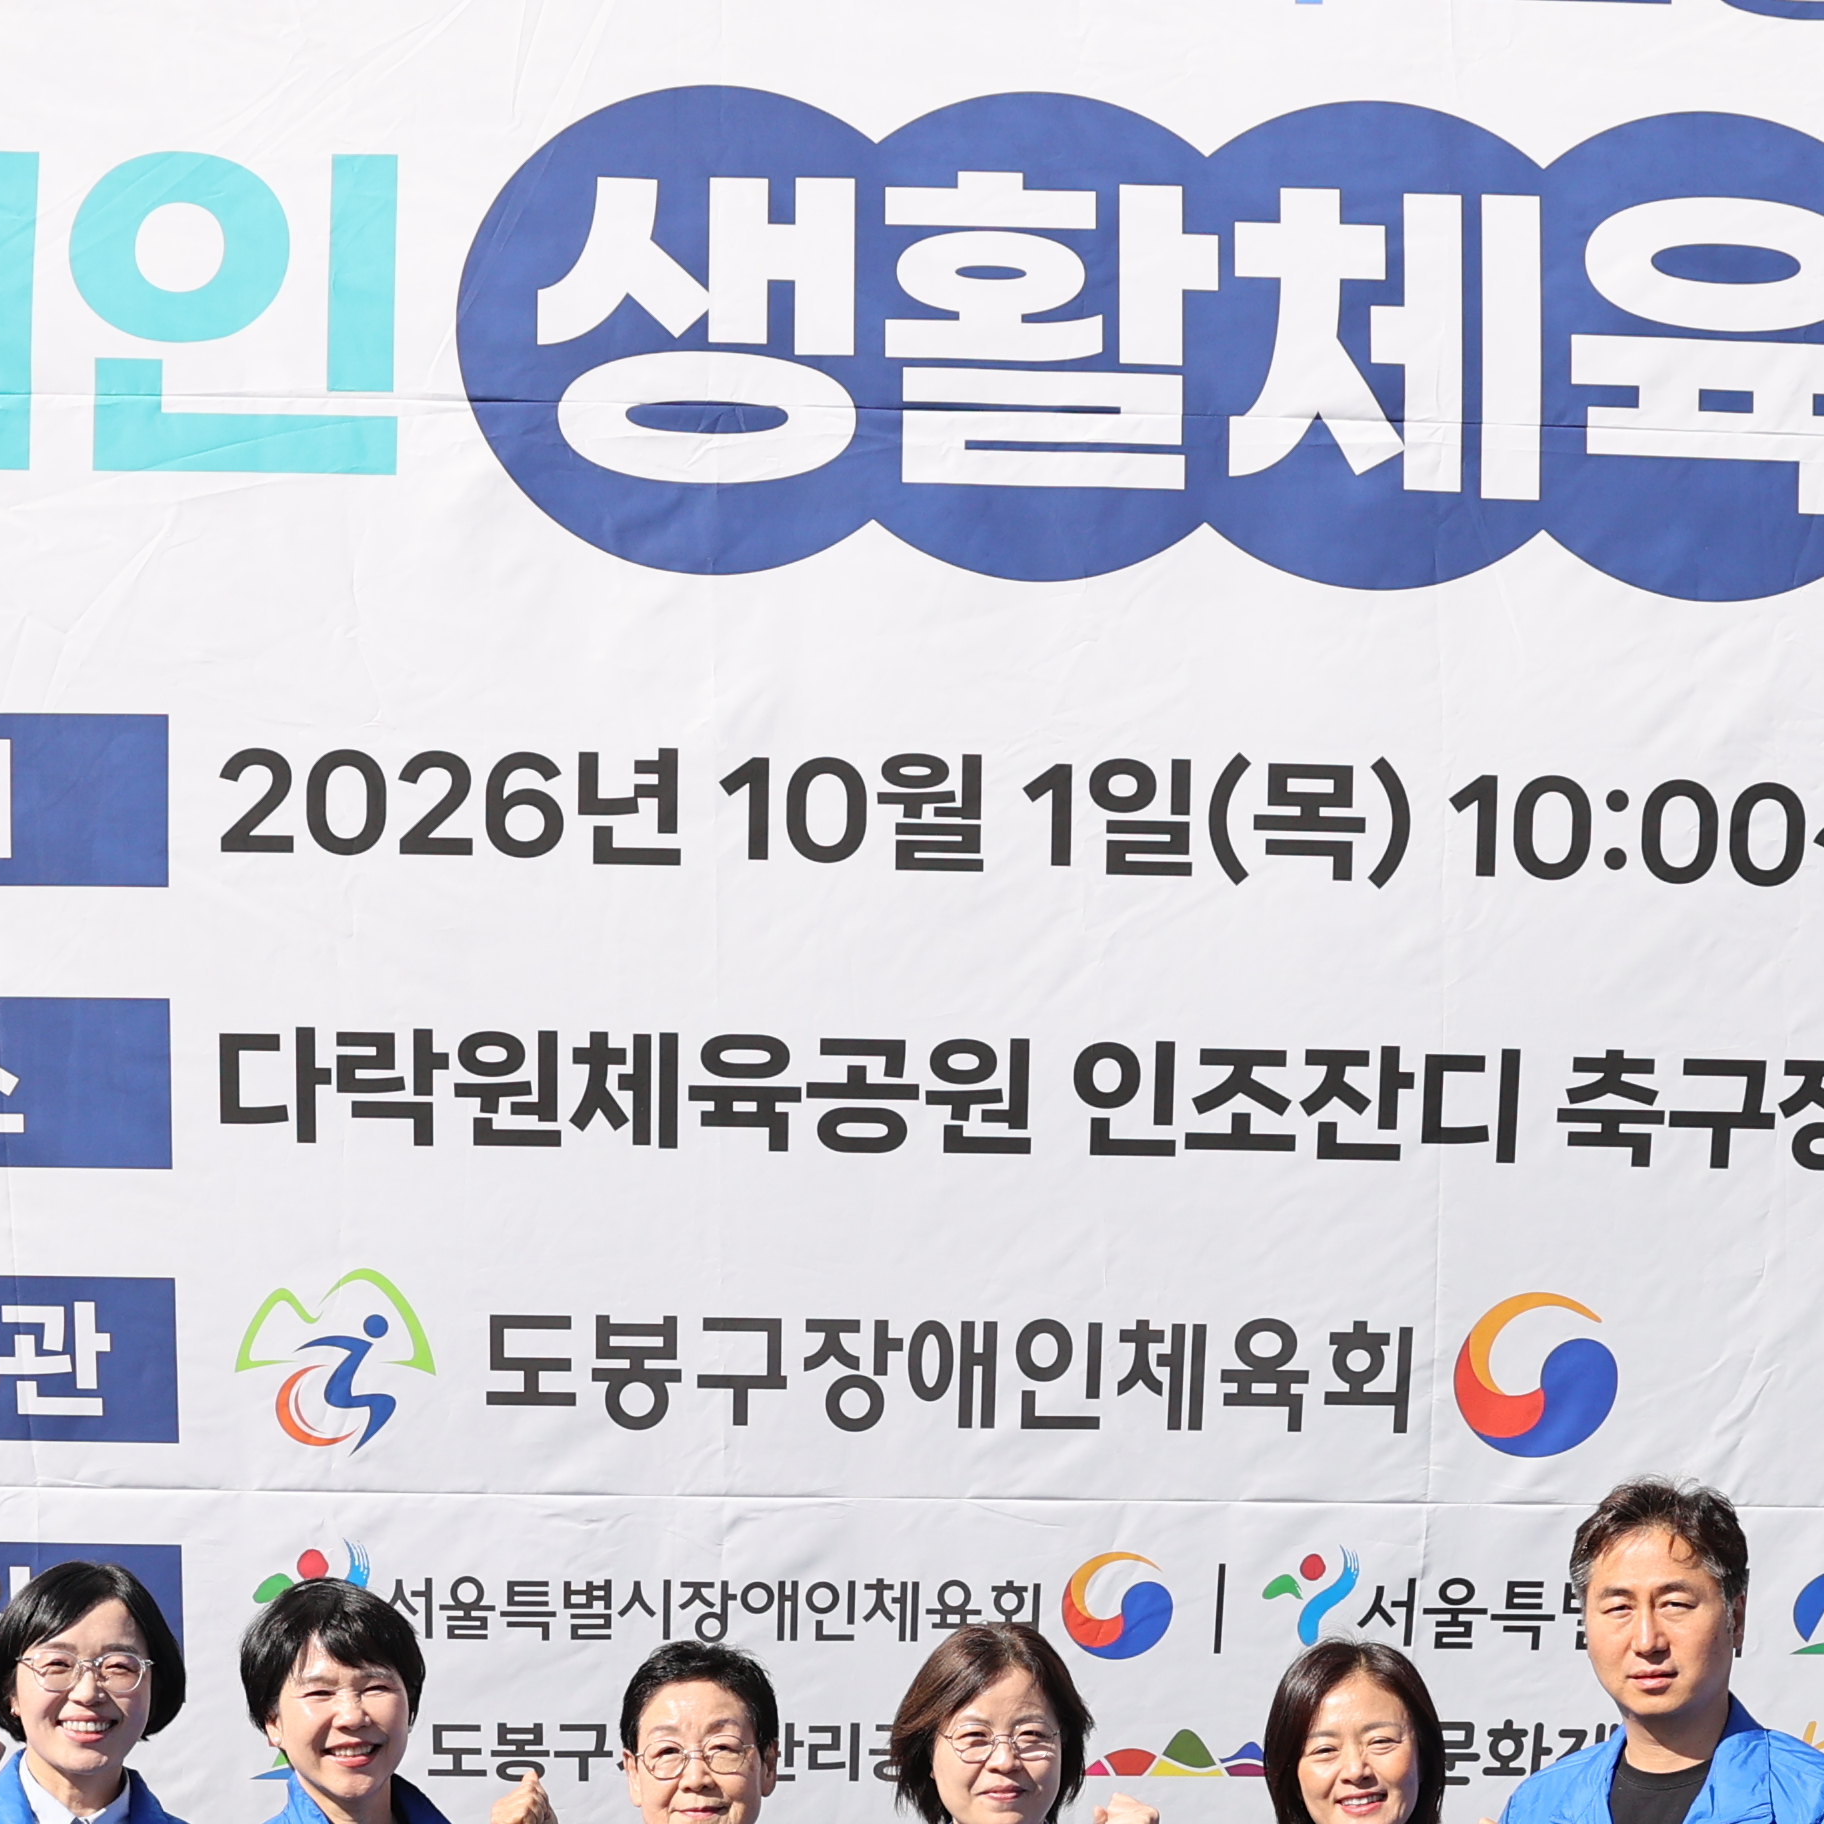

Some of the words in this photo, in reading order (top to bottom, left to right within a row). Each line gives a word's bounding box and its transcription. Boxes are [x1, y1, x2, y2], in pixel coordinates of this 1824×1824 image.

[219, 747, 682, 866] 2026년
[718, 753, 984, 872] 10월
[1022, 752, 1411, 890] 1일(목)
[219, 1026, 1032, 1155] 다락원체육공원
[1073, 1040, 1521, 1164] 인조잔디
[485, 1314, 1414, 1434] 도봉구장애인체육회
[387, 1575, 1042, 1643] 서울특별시장애인체육회
[1357, 1577, 1587, 1651] 서울특
